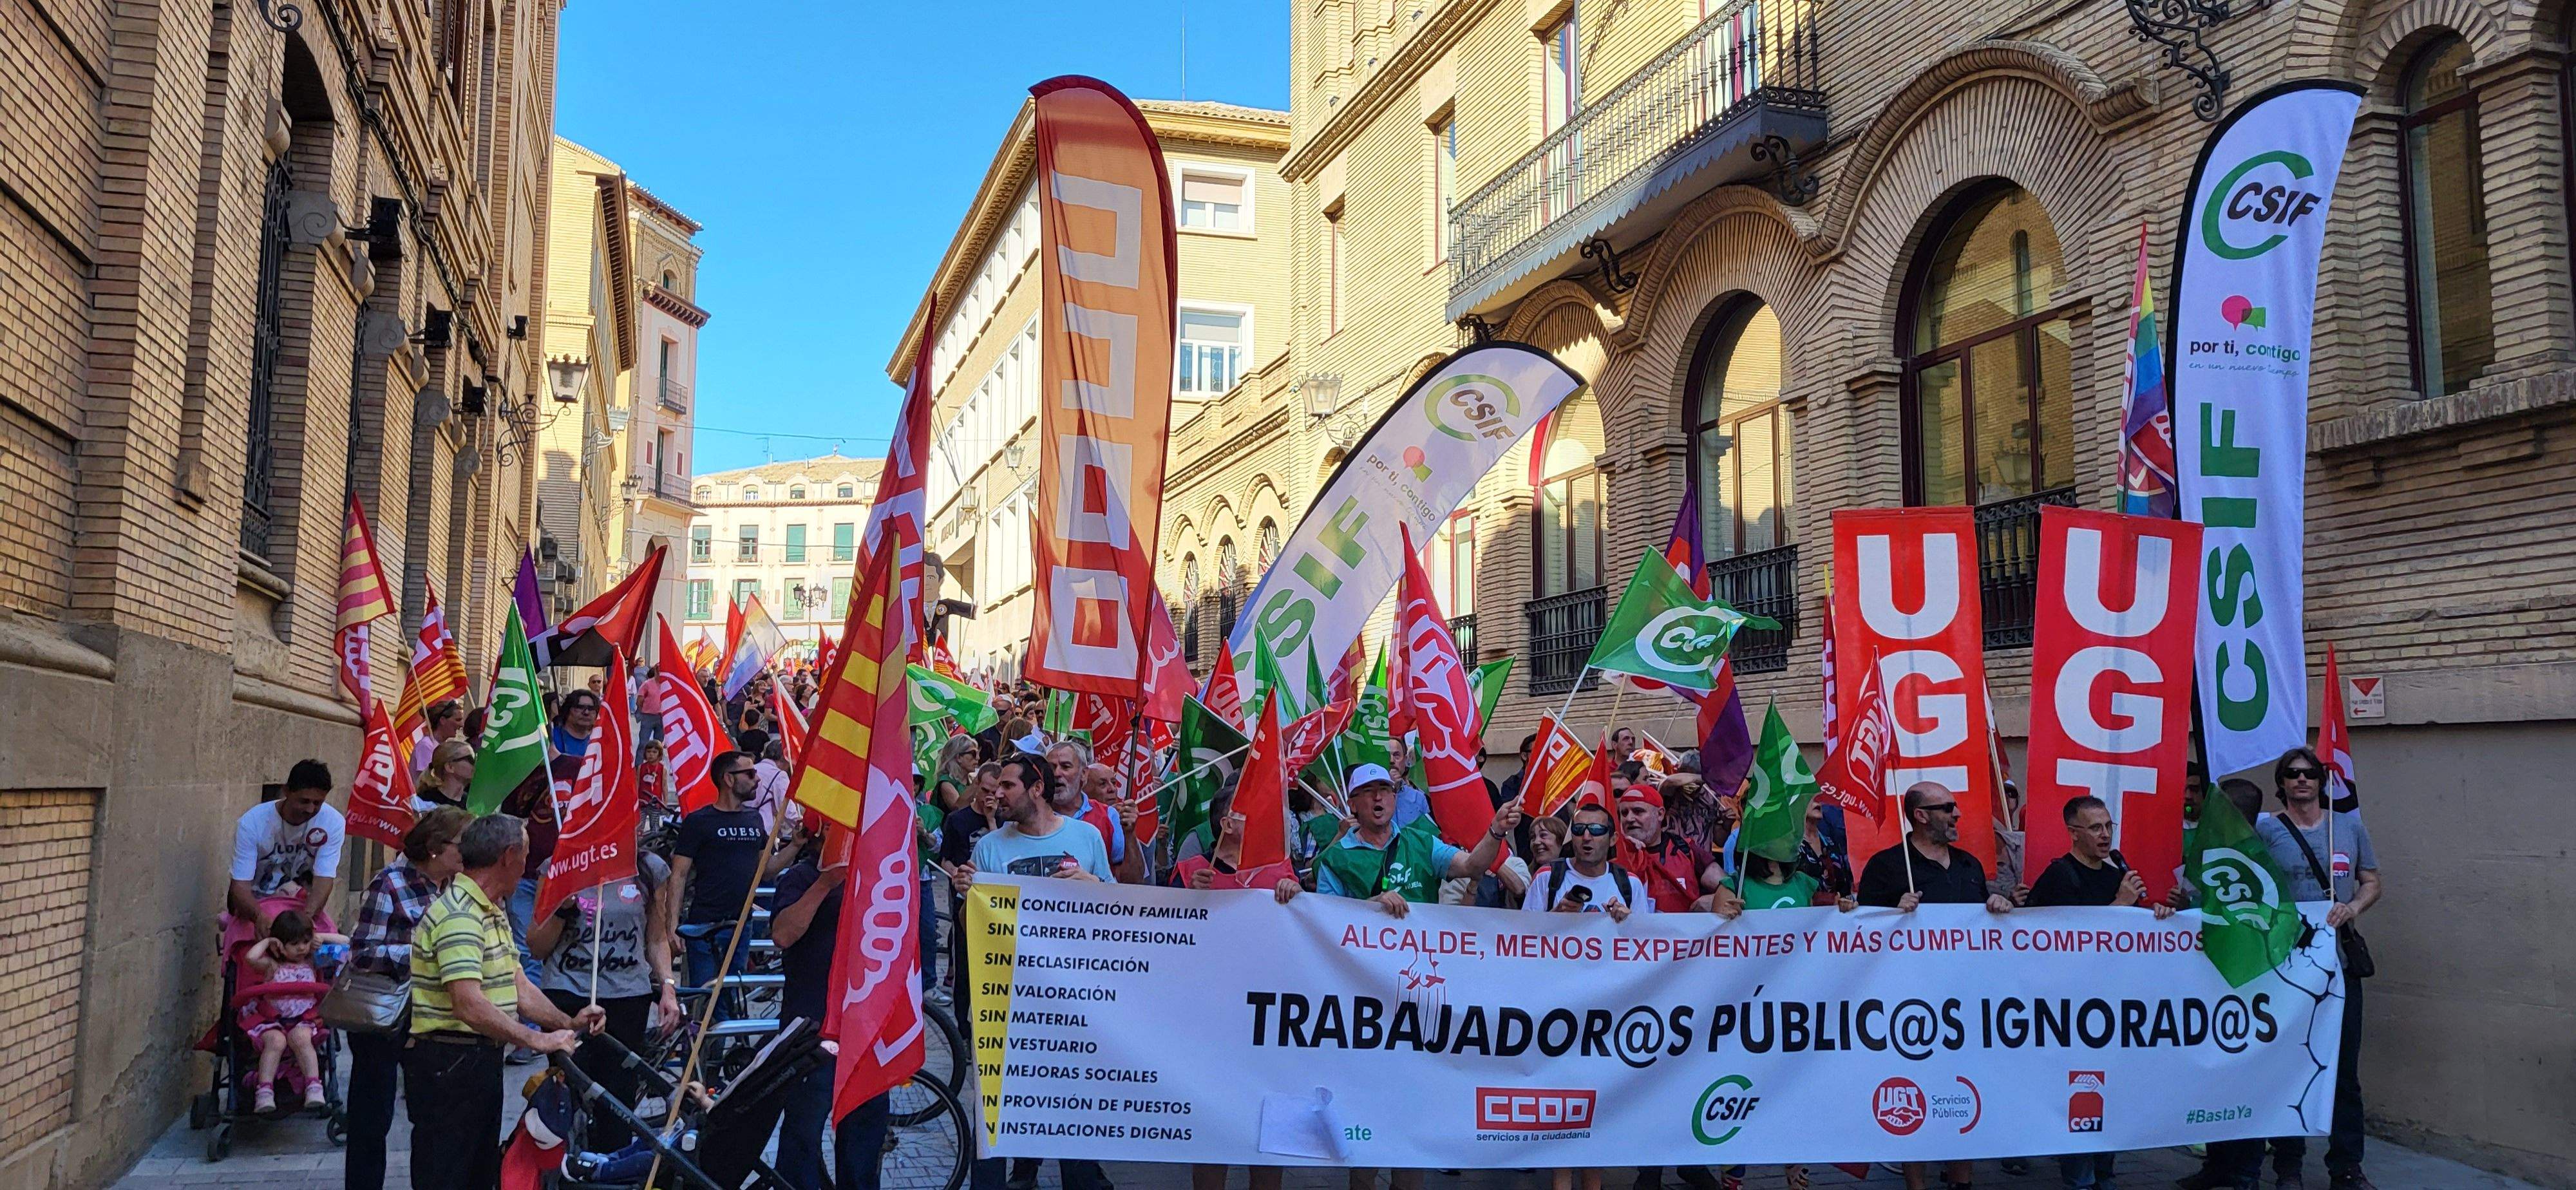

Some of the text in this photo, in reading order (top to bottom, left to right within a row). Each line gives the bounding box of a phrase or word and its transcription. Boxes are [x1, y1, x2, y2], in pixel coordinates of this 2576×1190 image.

[2227, 182, 2322, 227] CSIF
[2190, 337, 2301, 363] por ti, contigo
[1450, 388, 1516, 443] CSIF
[1367, 454, 1435, 522] por ti, contigo
[2200, 402, 2269, 732] CSIF
[2054, 527, 2173, 862] UGT
[1211, 681, 1244, 733] UG
[717, 827, 761, 837] GUESS
[990, 896, 1208, 920] SIN CONCILIACIÓN FAMILIAR
[987, 923, 1197, 946] SIN CARRERA PROFESIONAL
[1338, 924, 2204, 962] ALCALDE, MENOS EXPEDIENTES Y MÁS CUMPLIR COMPROMISOS
[985, 952, 1150, 973] SIN RECLASIFICACIÓN
[982, 983, 1116, 1001] SIN VALORACIÓN
[980, 1010, 1088, 1027] SIN MATERIAL
[1247, 985, 2278, 1069] TRABAJADOR@S PÚBLIC@S IGNORAD@S
[978, 1037, 1097, 1054] SIN VESTUARIO
[1005, 1064, 1080, 1080] MEJORAS
[1084, 1068, 1158, 1083] SOCIALES
[983, 1093, 1191, 1115] IN PROVISIÓN DE PUESTOS
[1879, 1086, 1918, 1108] UGT
[1931, 1095, 1970, 1106] Servicios
[1484, 1096, 1591, 1122] CCOO
[1705, 1097, 1760, 1121] CSIF
[1933, 1107, 1969, 1119] Públicos
[2186, 1106, 2252, 1125] #BastaYa
[1001, 1122, 1125, 1138] INSTALACIONES
[1130, 1126, 1192, 1140] DIGNAS
[2069, 1117, 2102, 1131] CGT
[1476, 1133, 1520, 1141] servicios
[1542, 1131, 1591, 1140] ciudadanía
